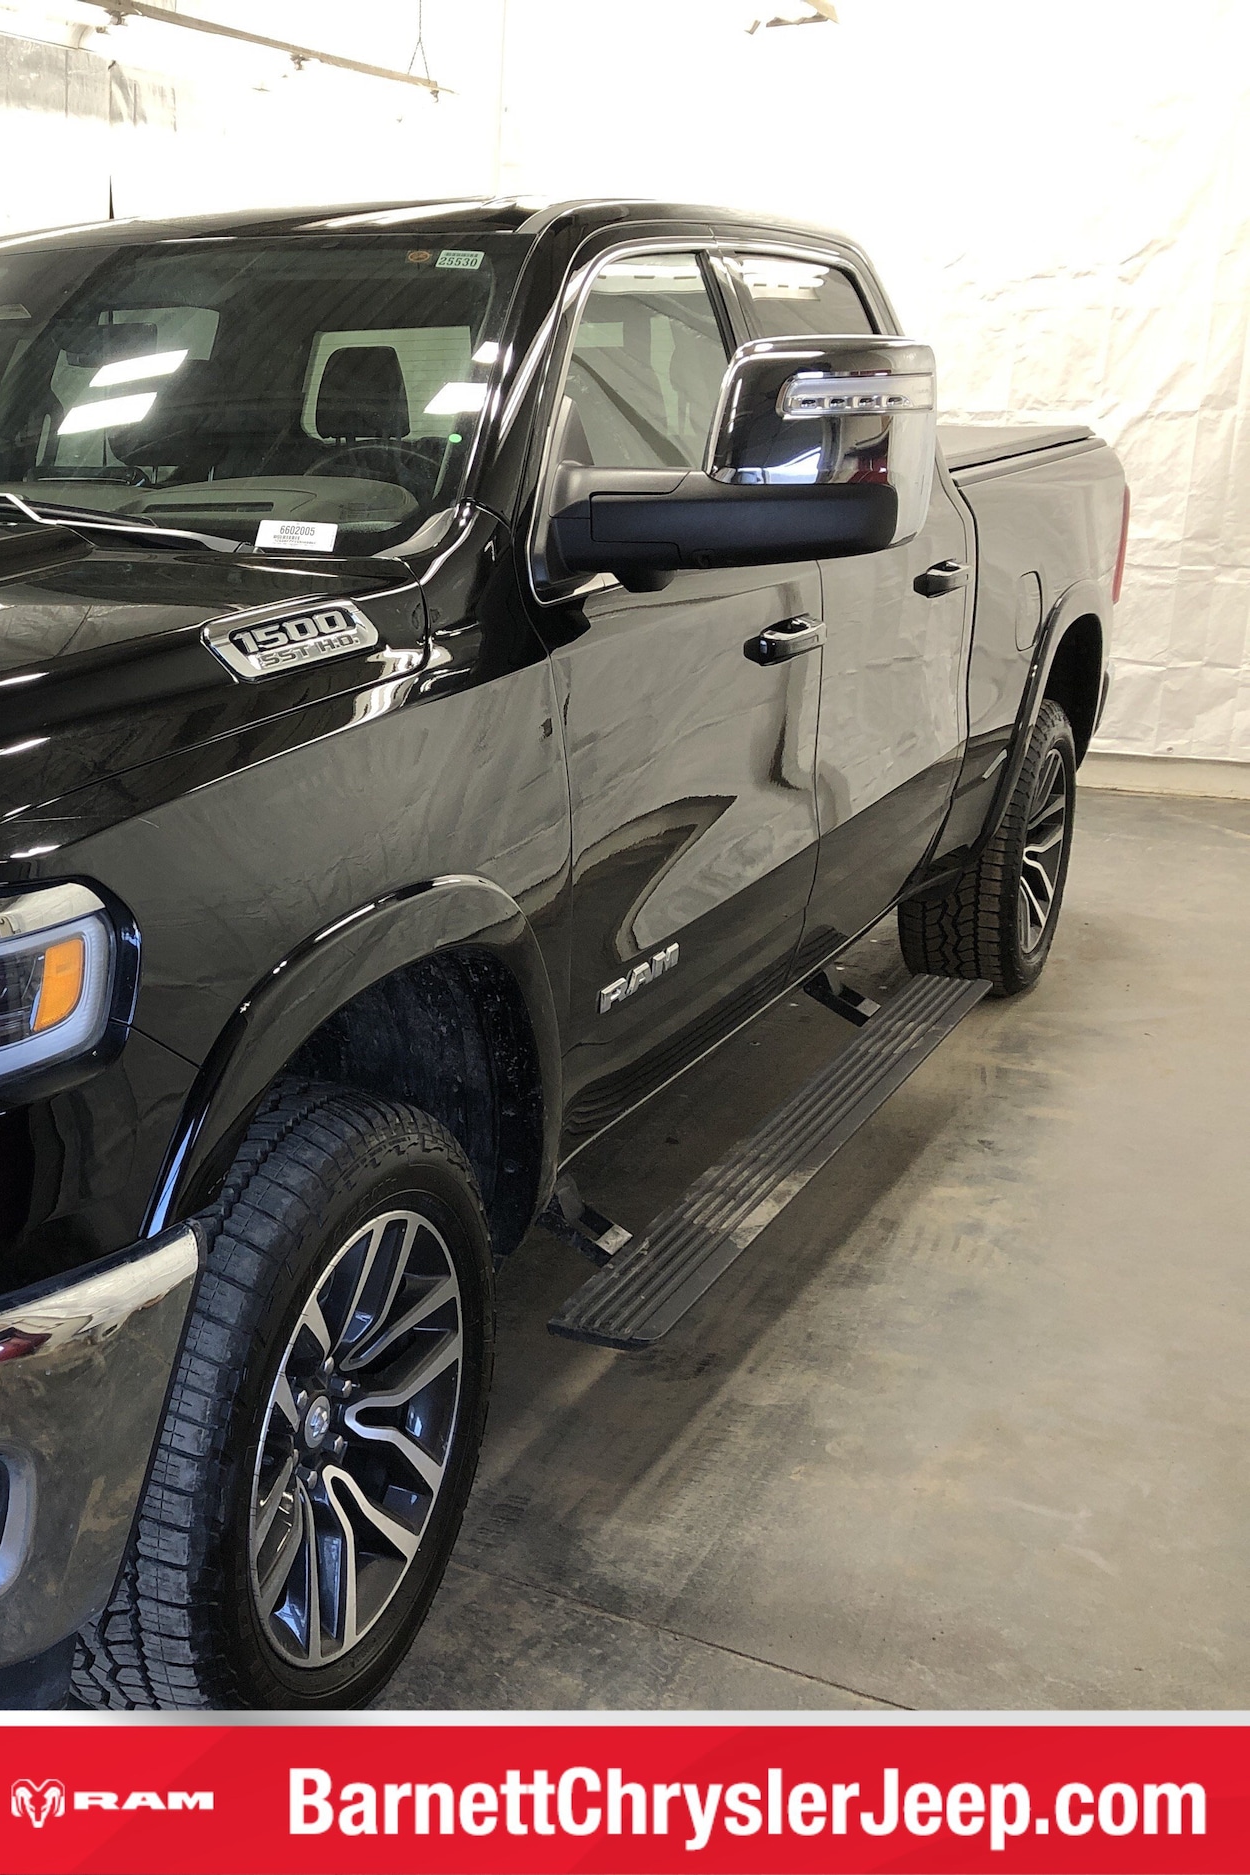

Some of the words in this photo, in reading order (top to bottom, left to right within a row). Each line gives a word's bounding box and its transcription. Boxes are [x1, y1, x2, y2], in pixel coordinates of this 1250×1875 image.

[438, 257, 478, 267] 25530
[280, 525, 316, 536] 6602005
[234, 611, 347, 653] 1500
[259, 647, 310, 667] SST
[596, 942, 680, 1014] RAM
